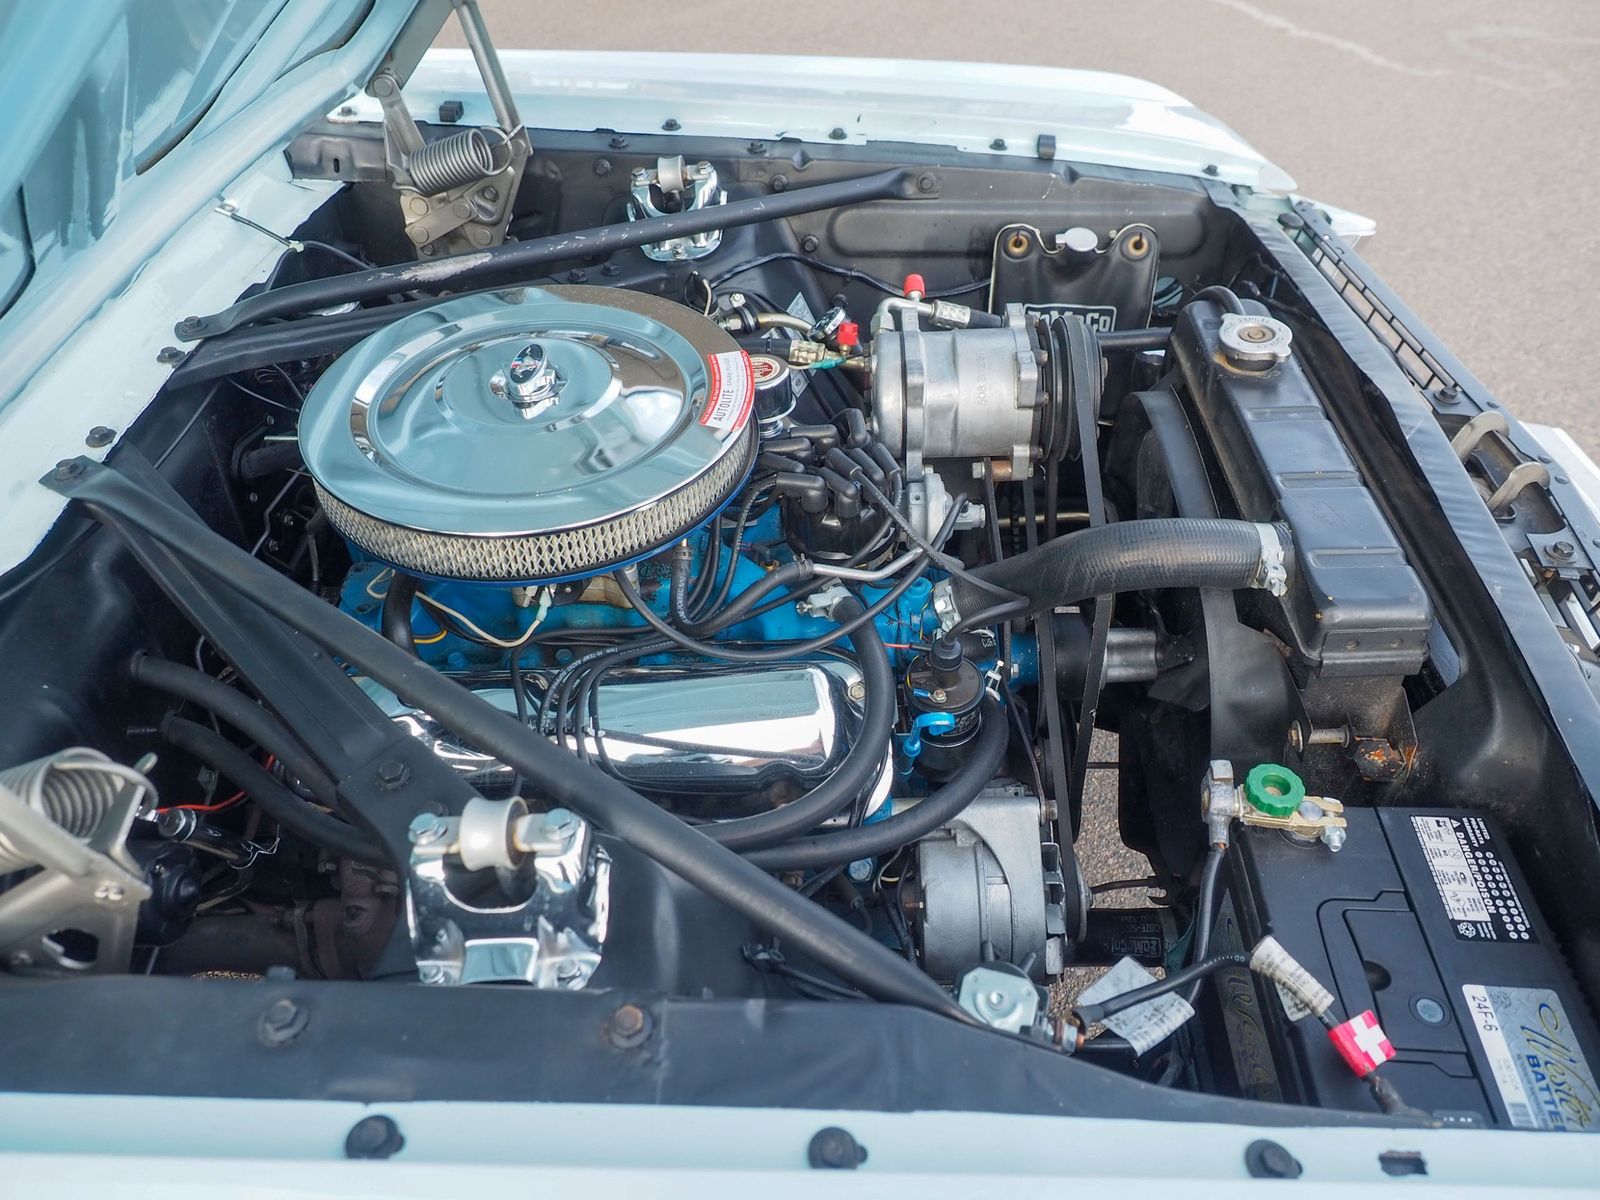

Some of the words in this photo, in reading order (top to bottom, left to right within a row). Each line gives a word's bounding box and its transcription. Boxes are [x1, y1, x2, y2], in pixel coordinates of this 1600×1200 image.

[713, 389, 734, 421] AUTOLITE
[1456, 832, 1497, 914] DANGER/POISON
[1472, 995, 1498, 1032] 24F-6
